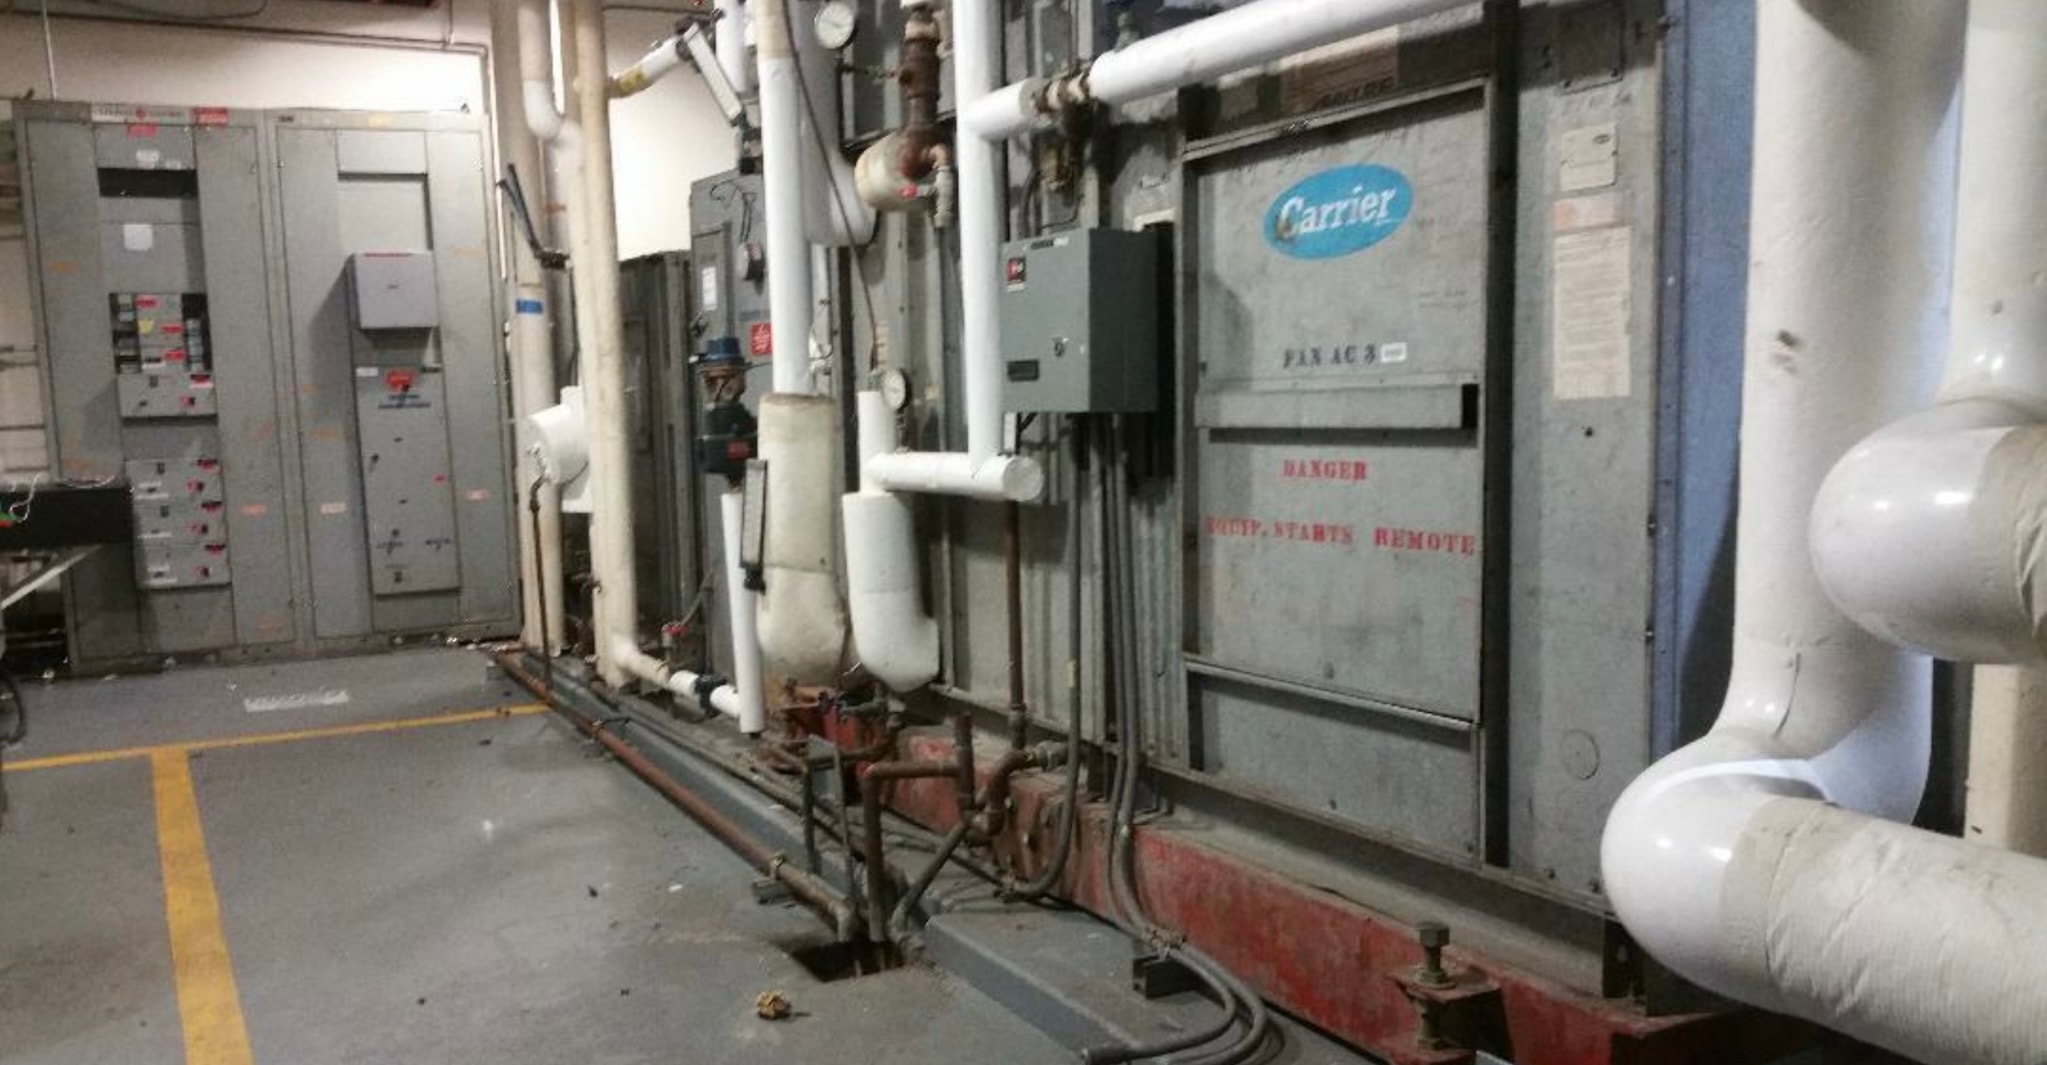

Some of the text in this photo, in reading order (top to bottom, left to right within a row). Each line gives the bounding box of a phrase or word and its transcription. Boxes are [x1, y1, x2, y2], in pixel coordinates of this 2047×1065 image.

[1278, 185, 1397, 239] Carrier
[1283, 459, 1367, 480] DANGER
[1375, 527, 1475, 555] REMOTE
